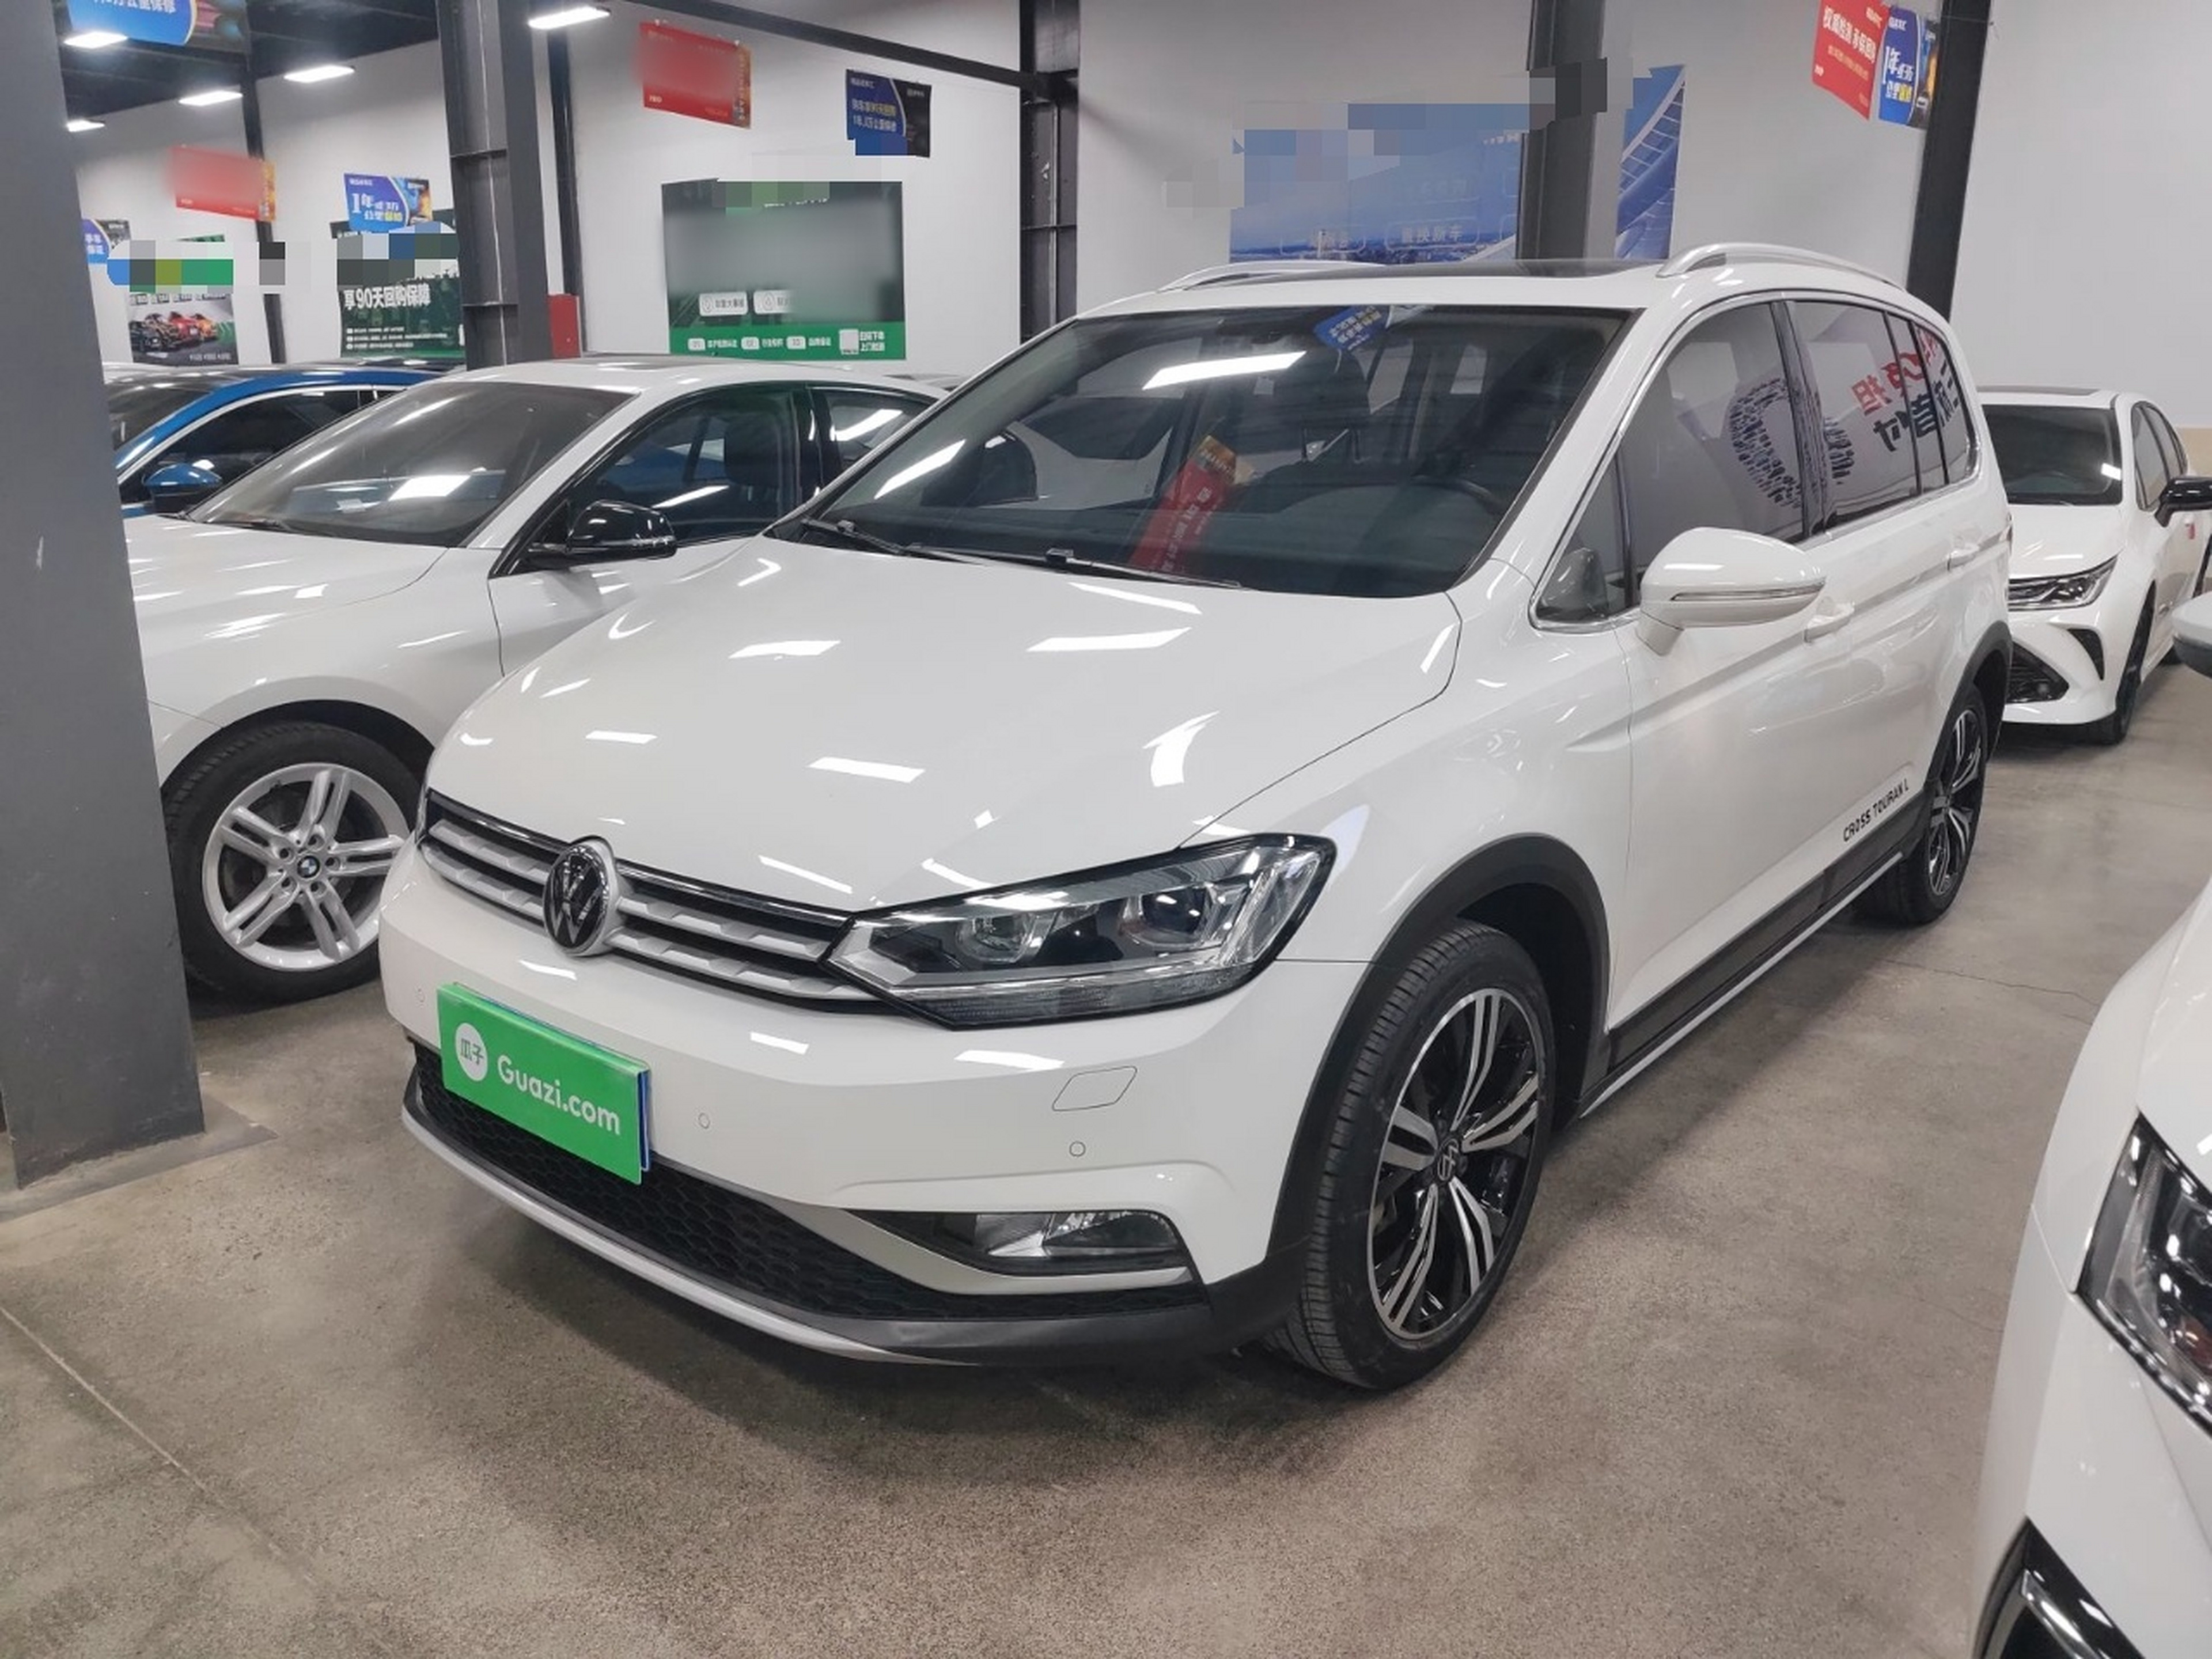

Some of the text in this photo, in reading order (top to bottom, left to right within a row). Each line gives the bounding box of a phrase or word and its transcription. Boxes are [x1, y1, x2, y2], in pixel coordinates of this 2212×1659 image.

[343, 283, 431, 310] 享90天回购保障
[1843, 778, 1910, 842] CROSS TOURAN L
[460, 1038, 484, 1066] 瓜子
[497, 1055, 620, 1135] Guazi.com
